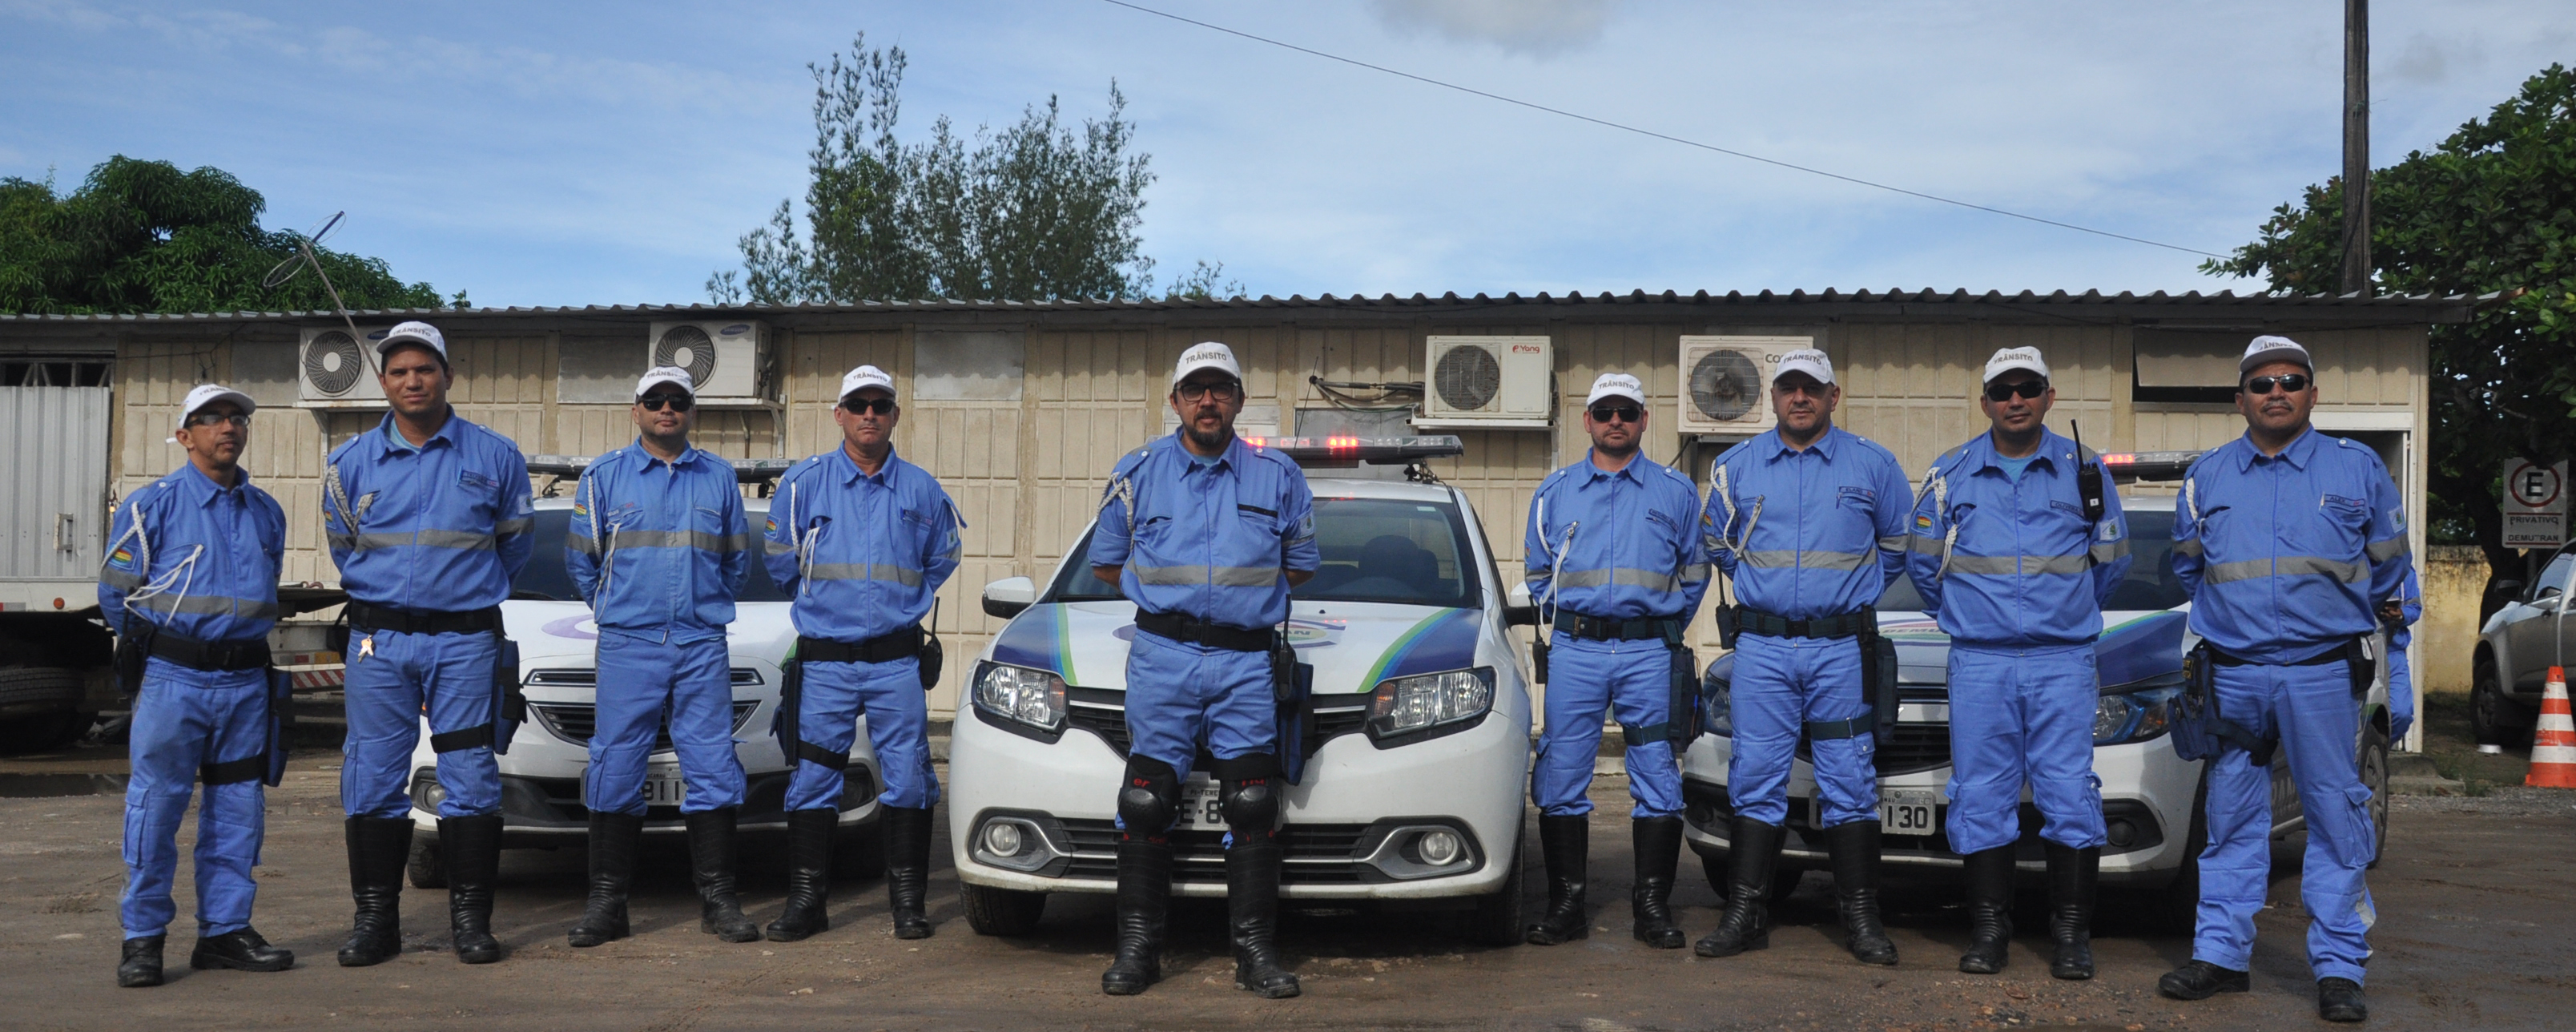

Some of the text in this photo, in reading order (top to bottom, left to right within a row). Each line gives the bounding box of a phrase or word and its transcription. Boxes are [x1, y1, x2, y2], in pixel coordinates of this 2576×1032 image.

[1520, 345, 1540, 353] Yang
[1185, 352, 1227, 365] TRÂNSITO
[1784, 354, 1822, 365] TRÂNSITO
[1994, 353, 2033, 365] TRÂNSITO
[1599, 381, 1635, 389] TRÂNSITO
[2526, 472, 2544, 497] E
